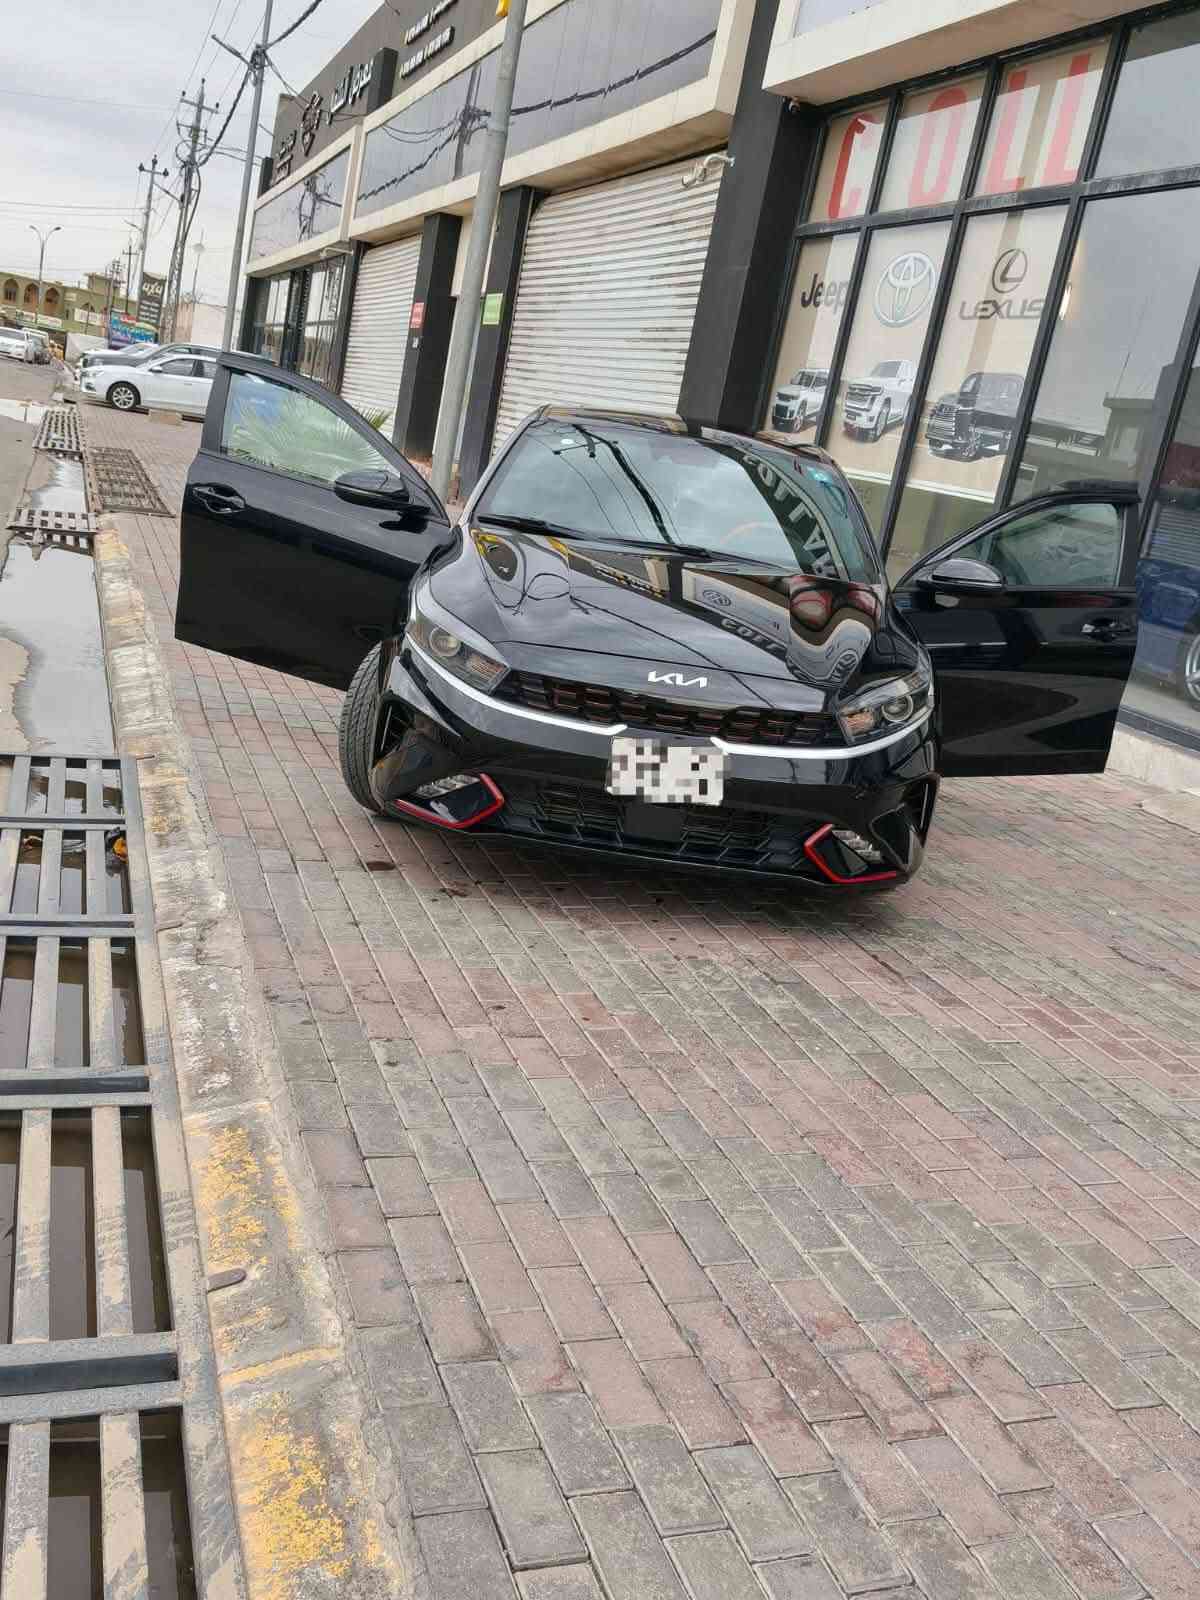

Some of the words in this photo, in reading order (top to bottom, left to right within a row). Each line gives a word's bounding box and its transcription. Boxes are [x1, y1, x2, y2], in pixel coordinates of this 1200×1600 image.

[801, 273, 849, 315] Jeep
[960, 299, 1046, 320] LEXUS
[647, 670, 708, 688] KIA
